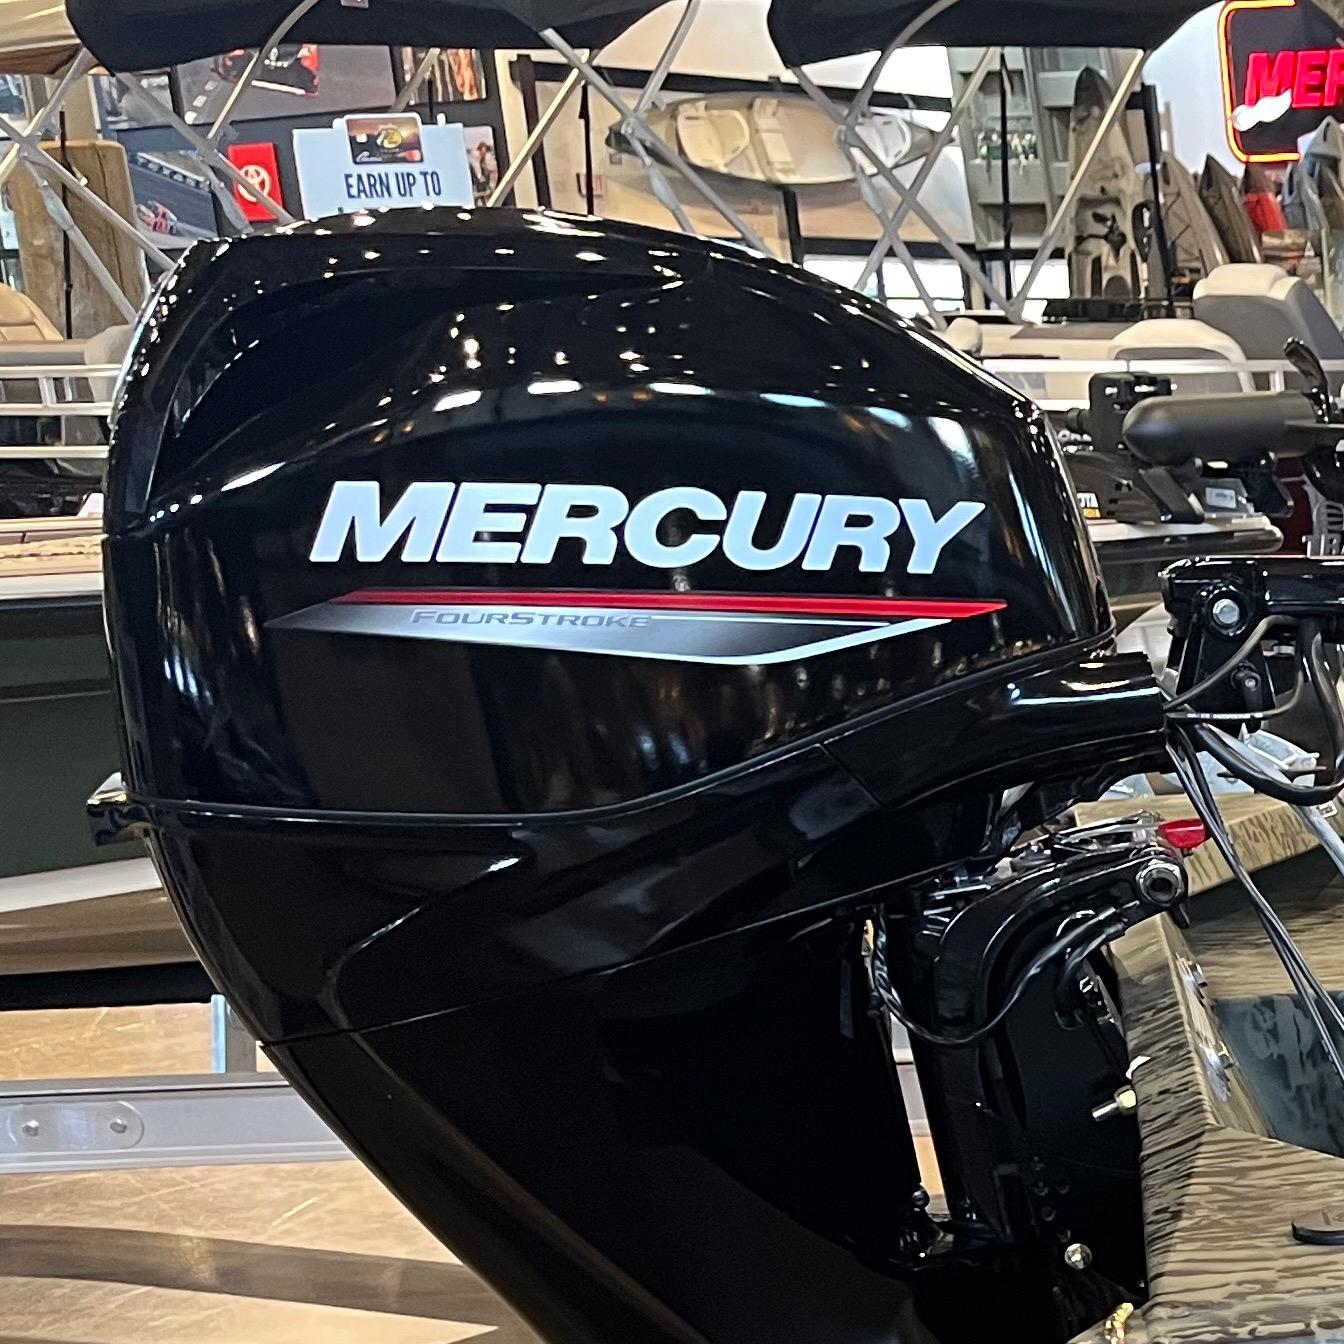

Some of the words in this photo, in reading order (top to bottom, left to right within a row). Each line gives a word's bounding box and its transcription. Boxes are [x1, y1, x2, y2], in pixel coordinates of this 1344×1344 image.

[344, 172, 392, 199] EARN
[395, 171, 416, 198] UP
[420, 170, 442, 197] TO
[310, 480, 986, 576] MERCURY
